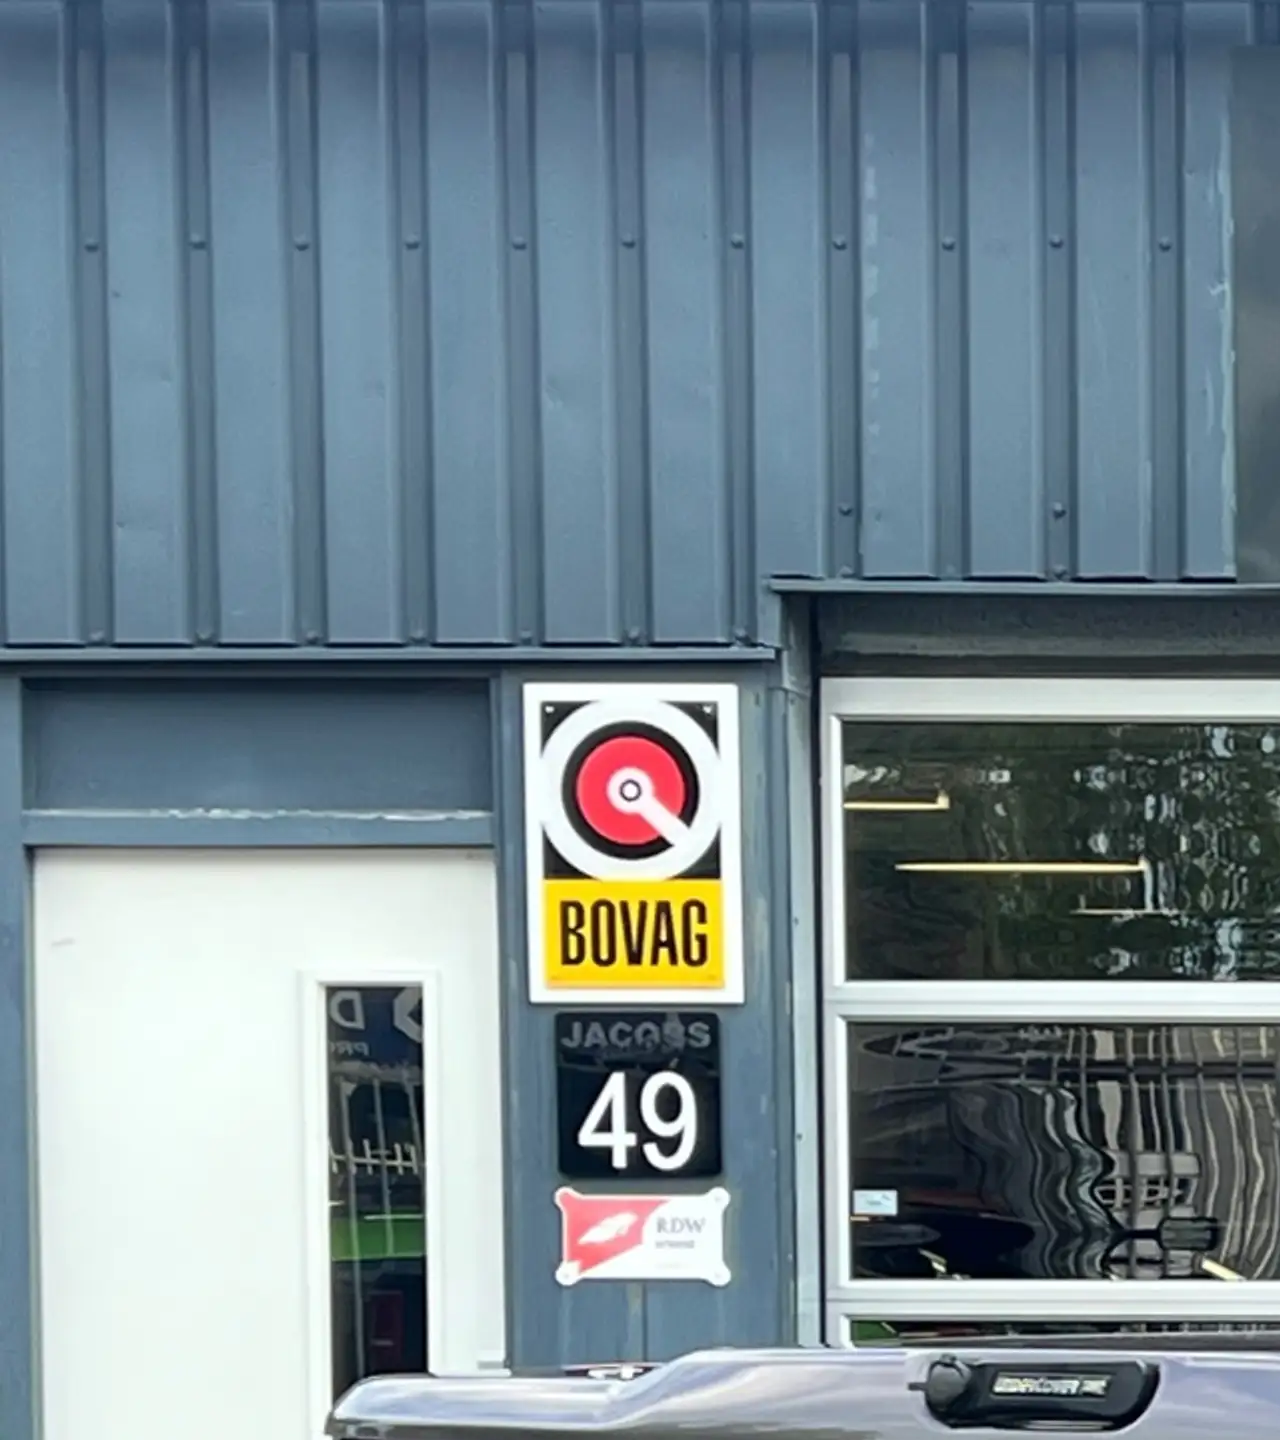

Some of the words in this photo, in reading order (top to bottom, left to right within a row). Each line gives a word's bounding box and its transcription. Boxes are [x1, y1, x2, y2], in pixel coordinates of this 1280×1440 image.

[560, 900, 708, 967] BOVAG
[578, 1071, 699, 1169] 49
[656, 1217, 706, 1234] RDW
